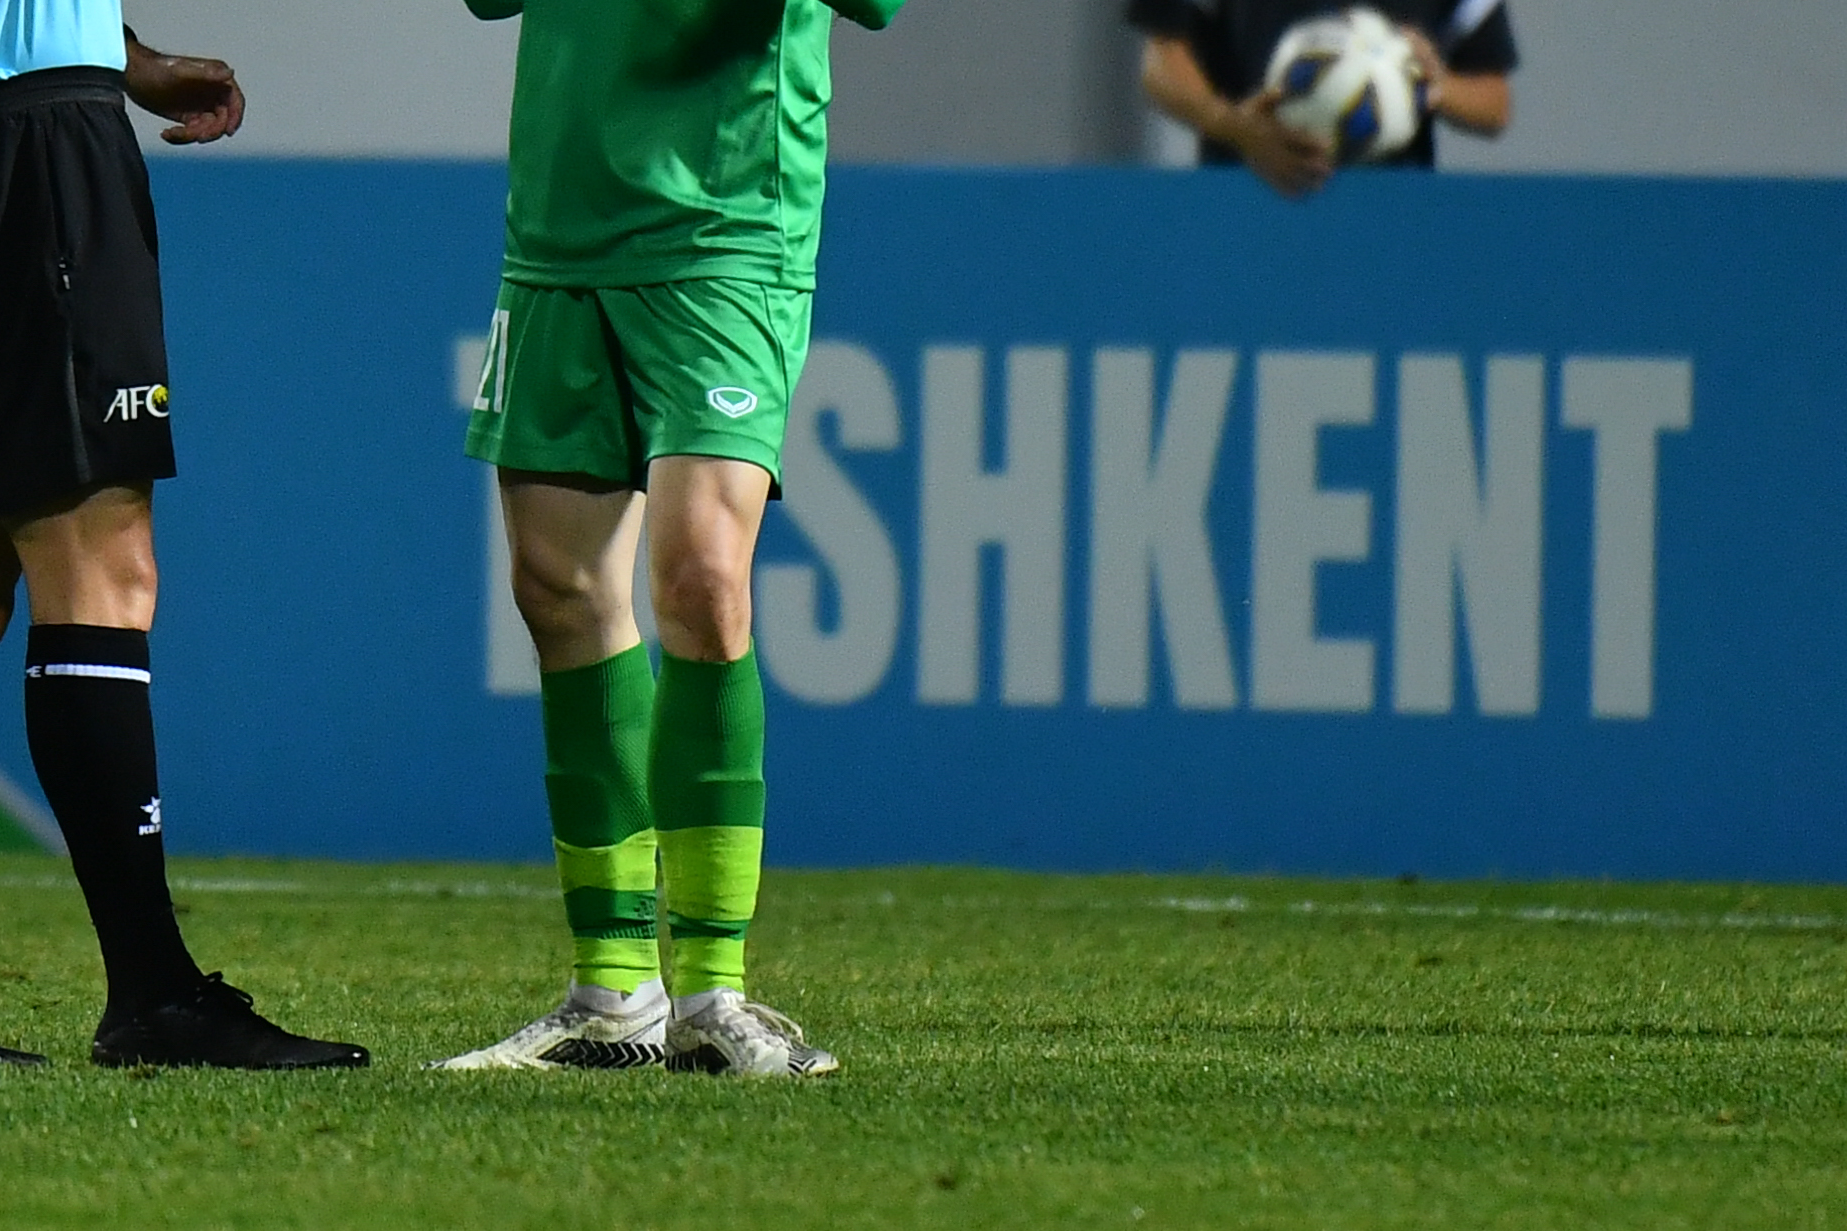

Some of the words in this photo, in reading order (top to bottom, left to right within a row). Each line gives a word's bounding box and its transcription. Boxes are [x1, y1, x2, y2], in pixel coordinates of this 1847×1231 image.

[103, 383, 170, 423] AFC
[473, 308, 510, 413] 21
[455, 336, 1694, 720] SHKENT
